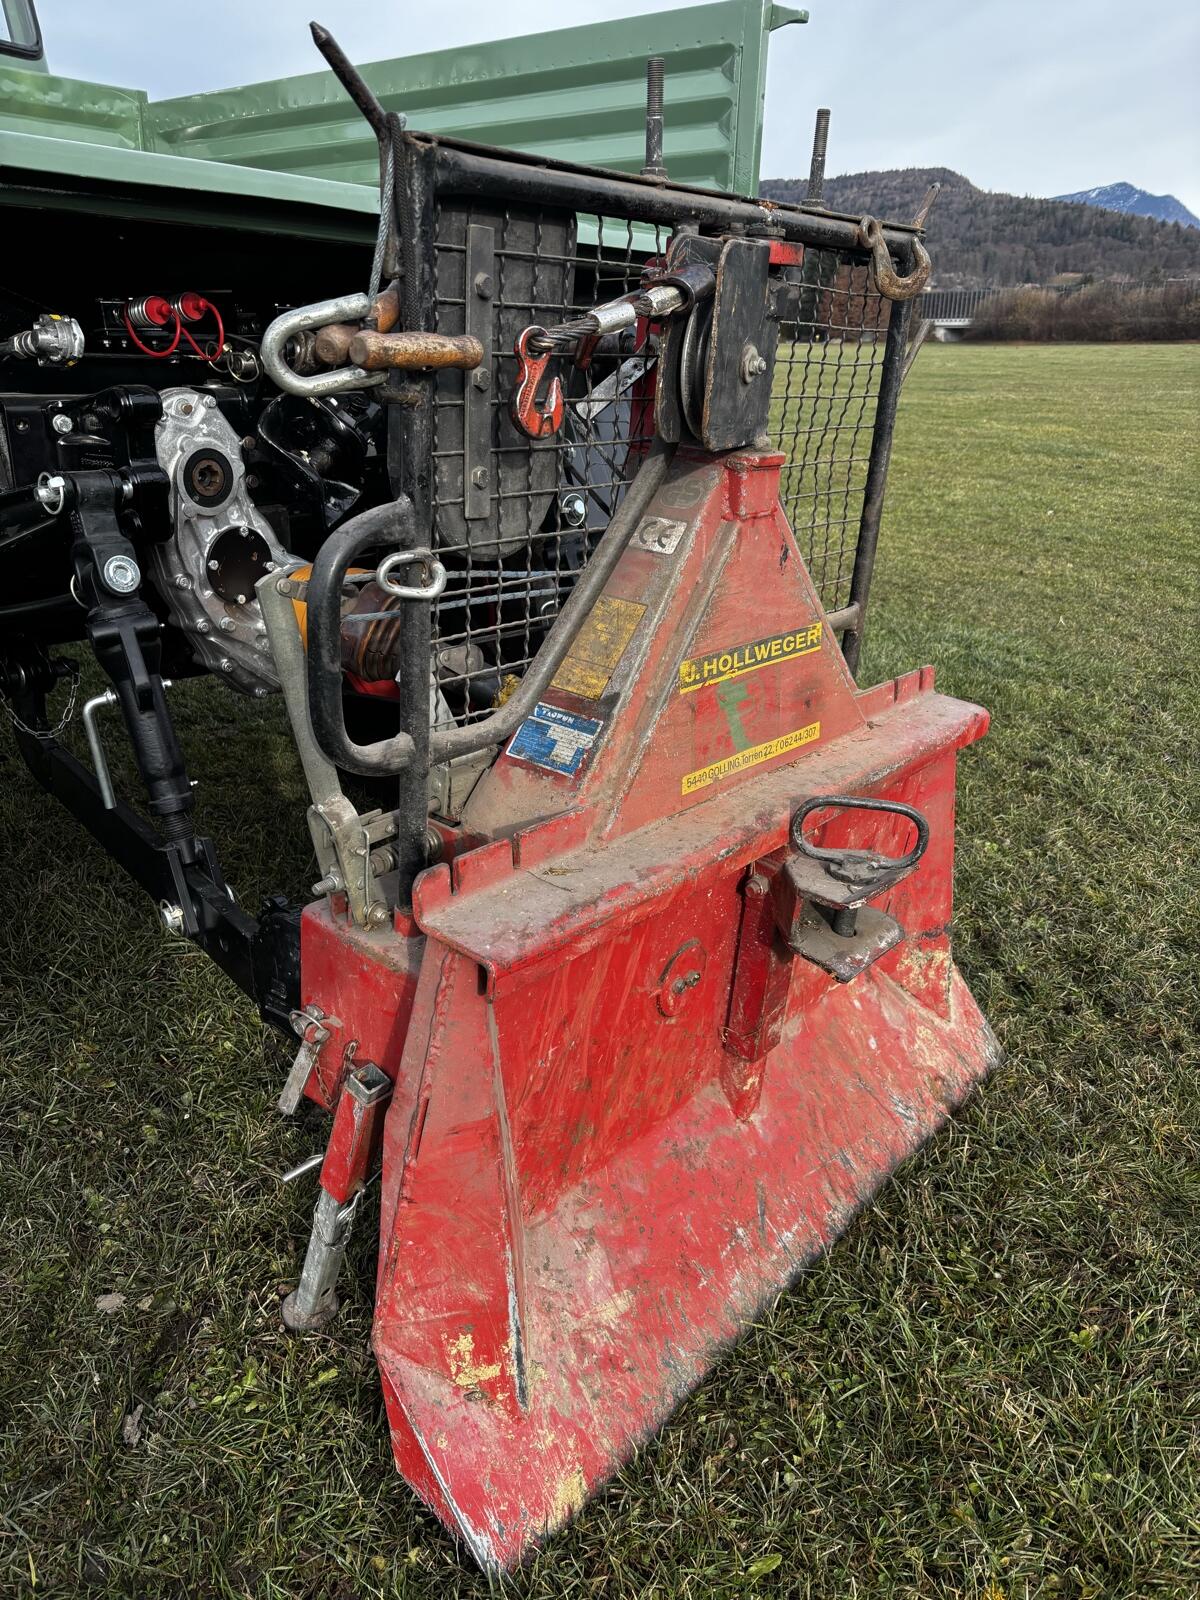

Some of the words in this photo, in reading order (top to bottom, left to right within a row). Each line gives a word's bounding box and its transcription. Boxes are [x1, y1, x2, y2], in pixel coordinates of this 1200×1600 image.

[639, 521, 676, 549] CE
[703, 630, 818, 678] HOLLWEGER
[686, 771, 708, 788] 5440
[742, 750, 763, 765] Torren
